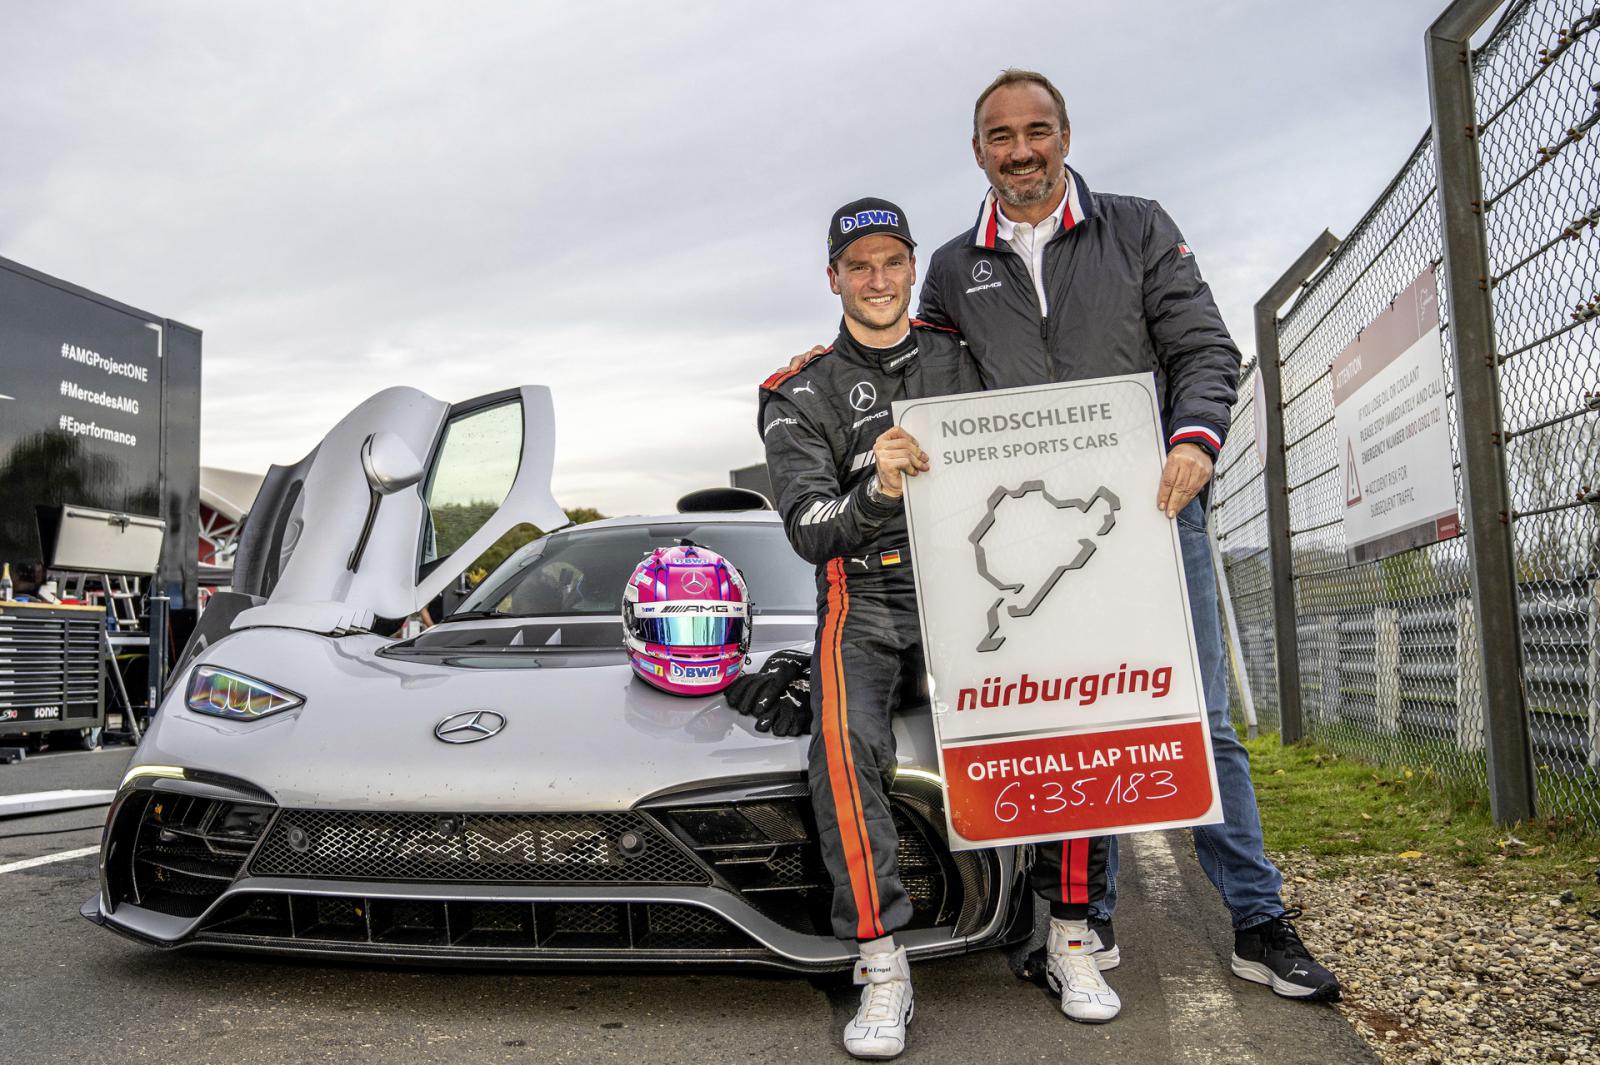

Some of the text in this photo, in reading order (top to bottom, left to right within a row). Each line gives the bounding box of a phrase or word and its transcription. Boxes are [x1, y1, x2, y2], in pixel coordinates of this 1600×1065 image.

[856, 209, 899, 228] BWT
[61, 342, 149, 382] #AMGProjectONE
[1335, 354, 1362, 390] ATTENTION
[60, 380, 139, 414] #MercedesAMG
[1361, 403, 1370, 419] YOU
[1370, 395, 1382, 412] LOSE
[1381, 389, 1389, 405] OIL
[1388, 383, 1396, 399] OR
[1396, 365, 1420, 394] COOLANT
[941, 403, 1112, 438] NORDSCHLEIFE
[1359, 377, 1441, 444] PLEASE STOP IMMEDIATELY AND CALL
[59, 415, 137, 446] #Eperformance
[1361, 440, 1386, 465] EMERGENCY
[1385, 428, 1405, 451] NUMBER
[943, 432, 1119, 465] SUPER SPORTS CARS
[1368, 465, 1407, 495] ACCIDENT RISK FOR
[1370, 488, 1414, 519] SUBSEQUENT TRAFFIC
[683, 605, 728, 613] AMG
[686, 666, 719, 677] BWT
[957, 664, 1172, 711] nürburgring
[967, 741, 1184, 781] OFFICIAL LAP TIME
[399, 828, 609, 863] AMG
